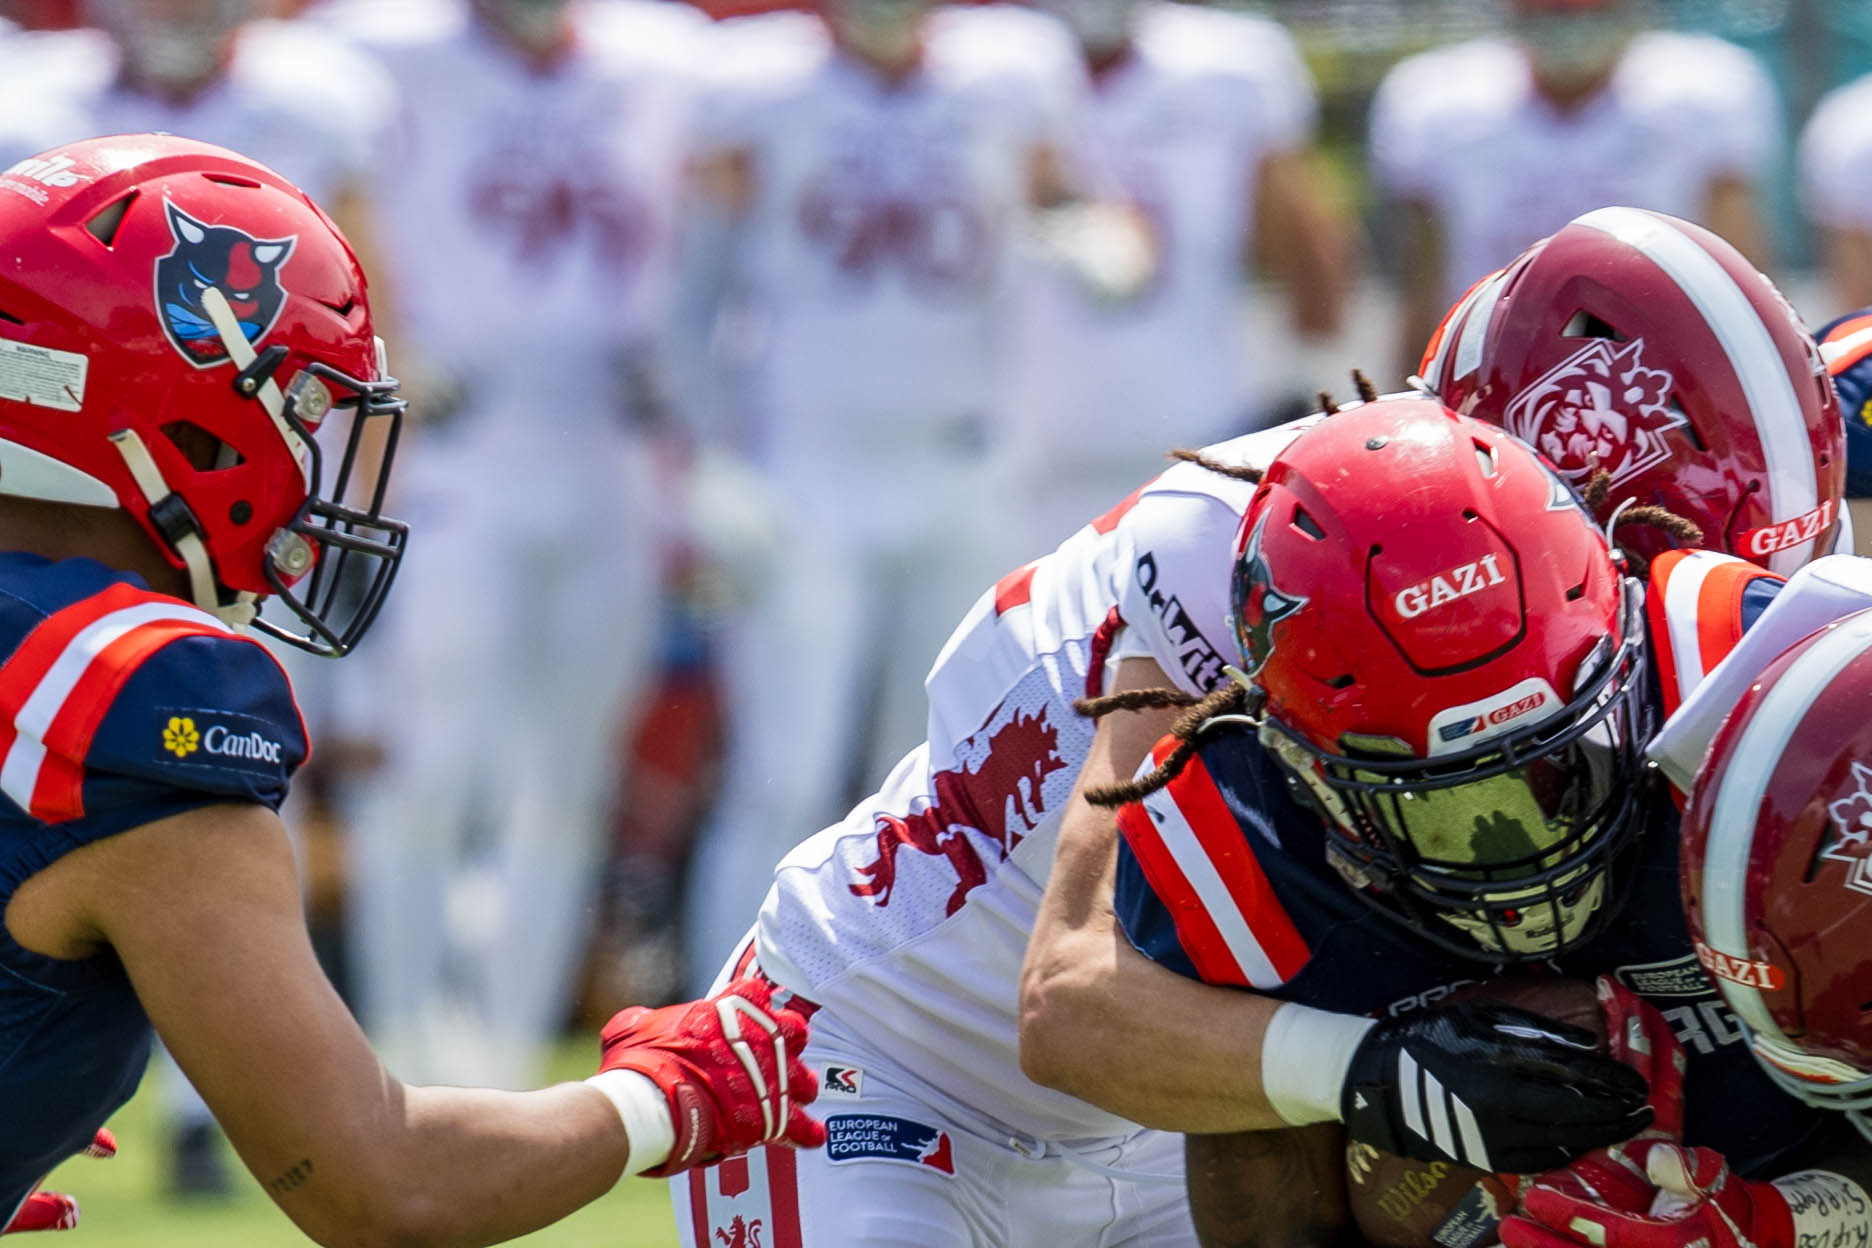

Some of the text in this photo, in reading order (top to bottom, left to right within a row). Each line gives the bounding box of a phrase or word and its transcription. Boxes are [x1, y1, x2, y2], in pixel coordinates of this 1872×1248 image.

[204, 725, 281, 764] CanDoc
[828, 1119, 898, 1132] EUROPEAN
[829, 1130, 880, 1143] LEAGUE
[830, 1141, 898, 1155] FOOTBALL
